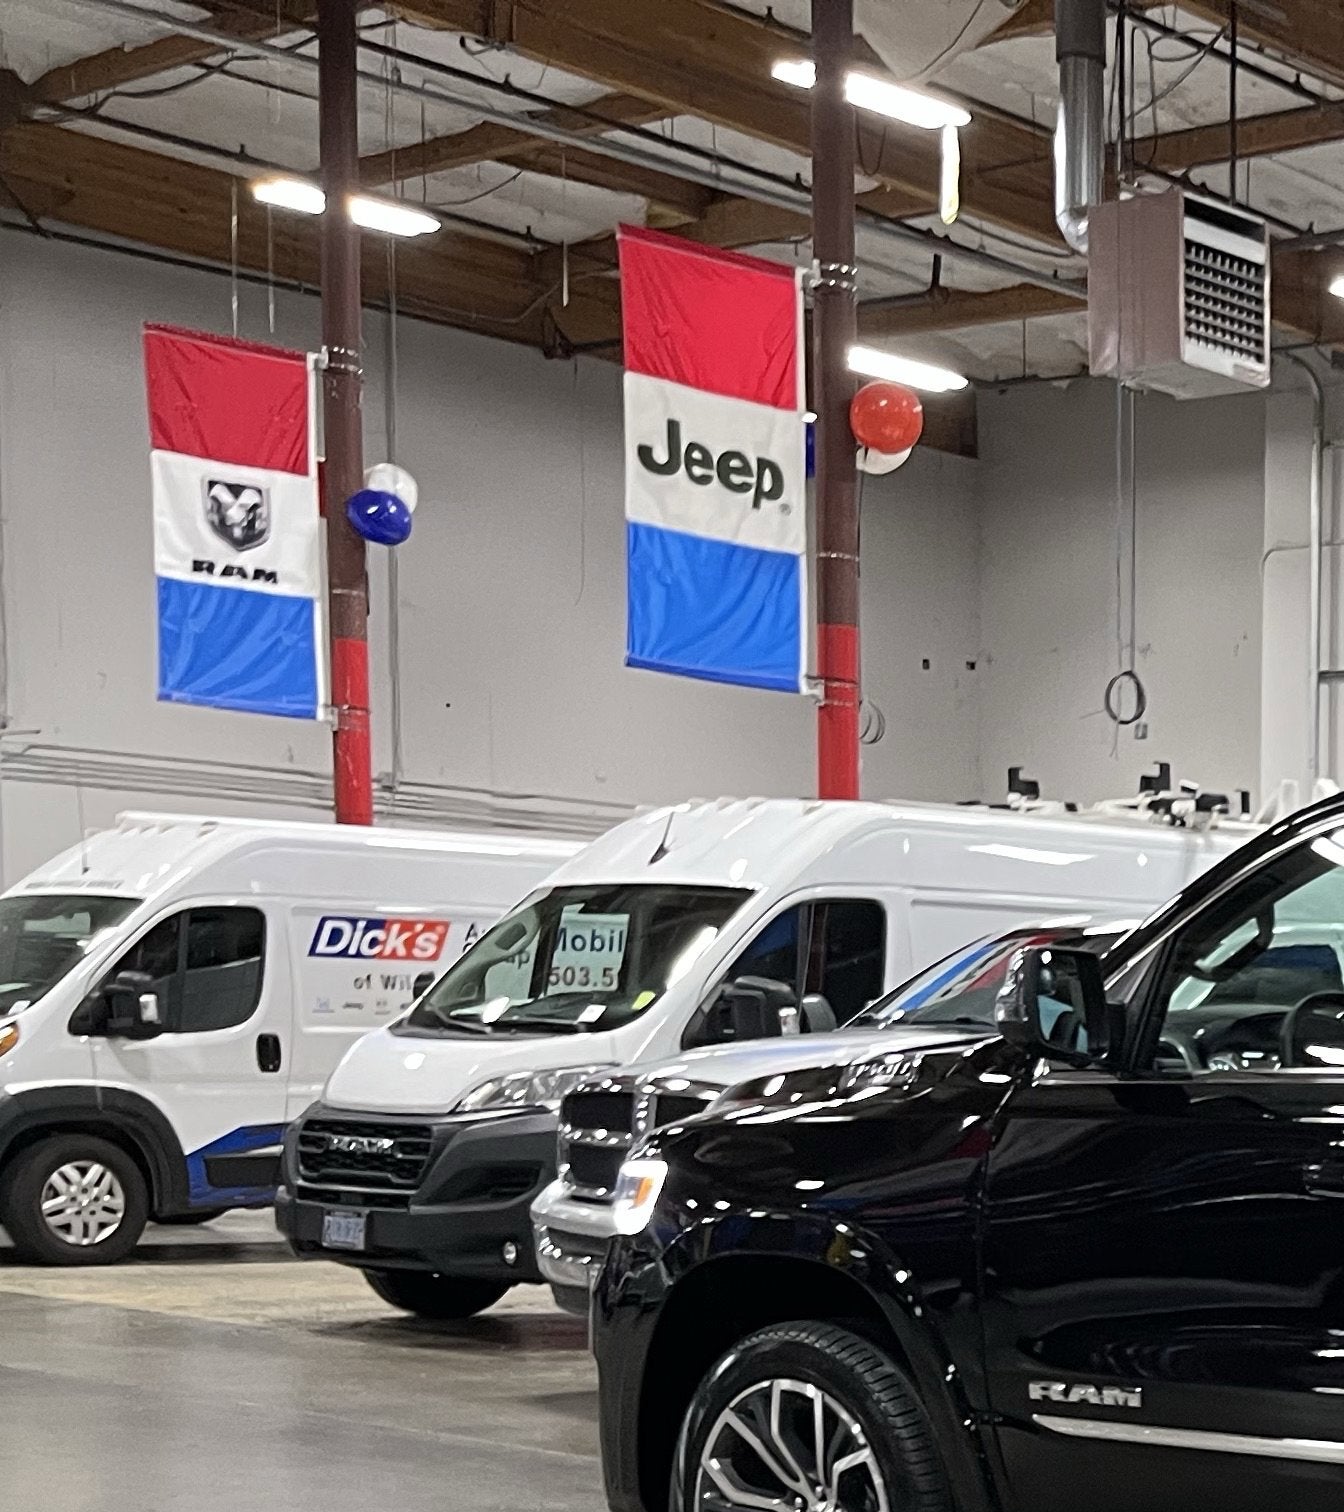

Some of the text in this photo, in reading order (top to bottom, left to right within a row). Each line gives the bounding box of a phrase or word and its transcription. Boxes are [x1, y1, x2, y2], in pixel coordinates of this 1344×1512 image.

[637, 418, 785, 510] Jeep
[192, 560, 279, 585] RAM
[1028, 1380, 1142, 1408] RAM
